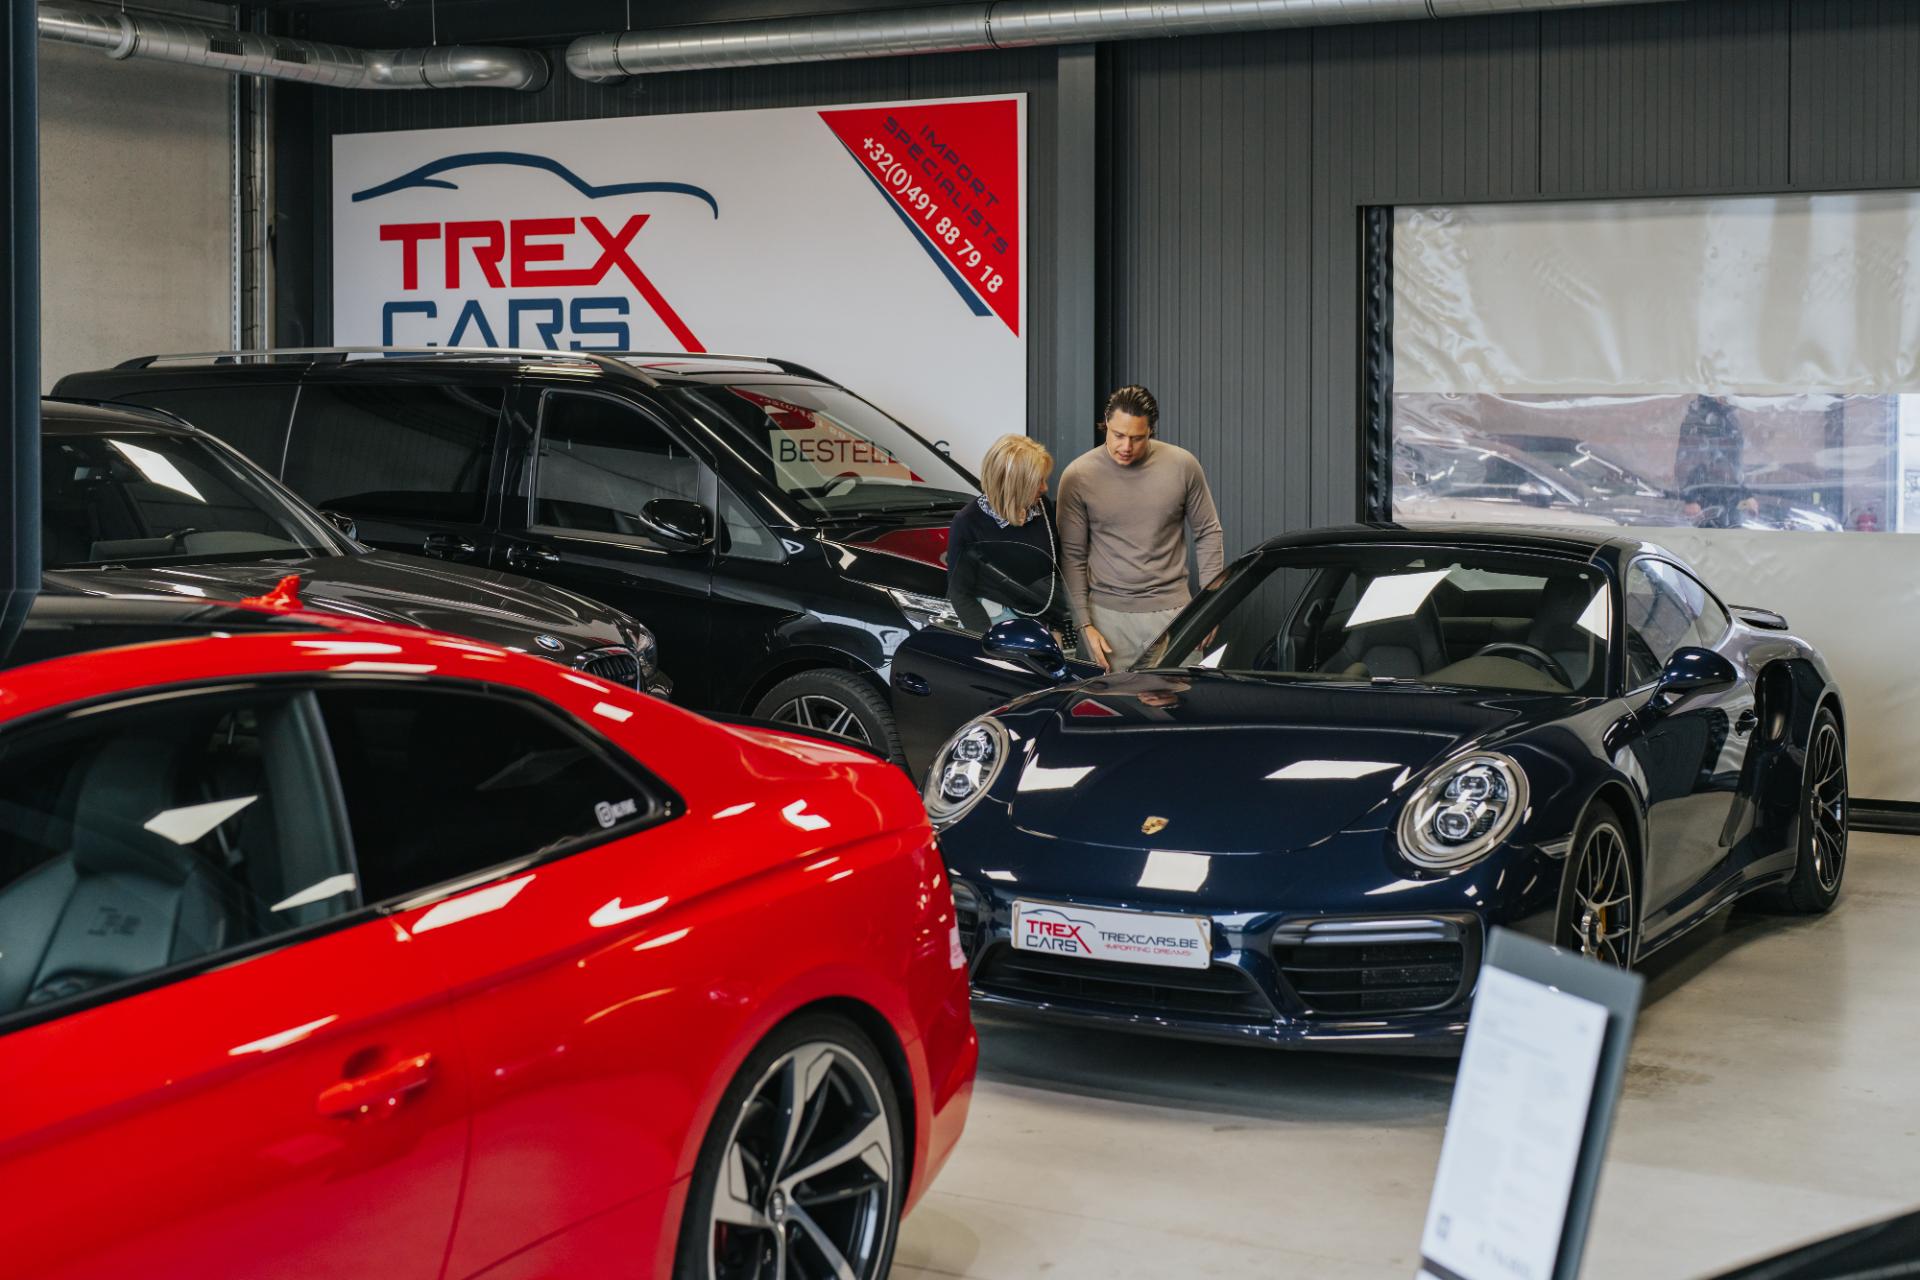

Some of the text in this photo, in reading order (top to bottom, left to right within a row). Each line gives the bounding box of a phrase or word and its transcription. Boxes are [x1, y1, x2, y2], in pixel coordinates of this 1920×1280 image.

[883, 115, 1009, 256] SPECIALISTS
[919, 124, 999, 208] IMPORT
[863, 137, 1004, 293] +32(0)491 88 79 18
[383, 297, 631, 352] CARS
[1026, 919, 1092, 954] TREX
[1026, 935, 1078, 953] CARS
[1099, 931, 1199, 949] TREXCARS.BE
